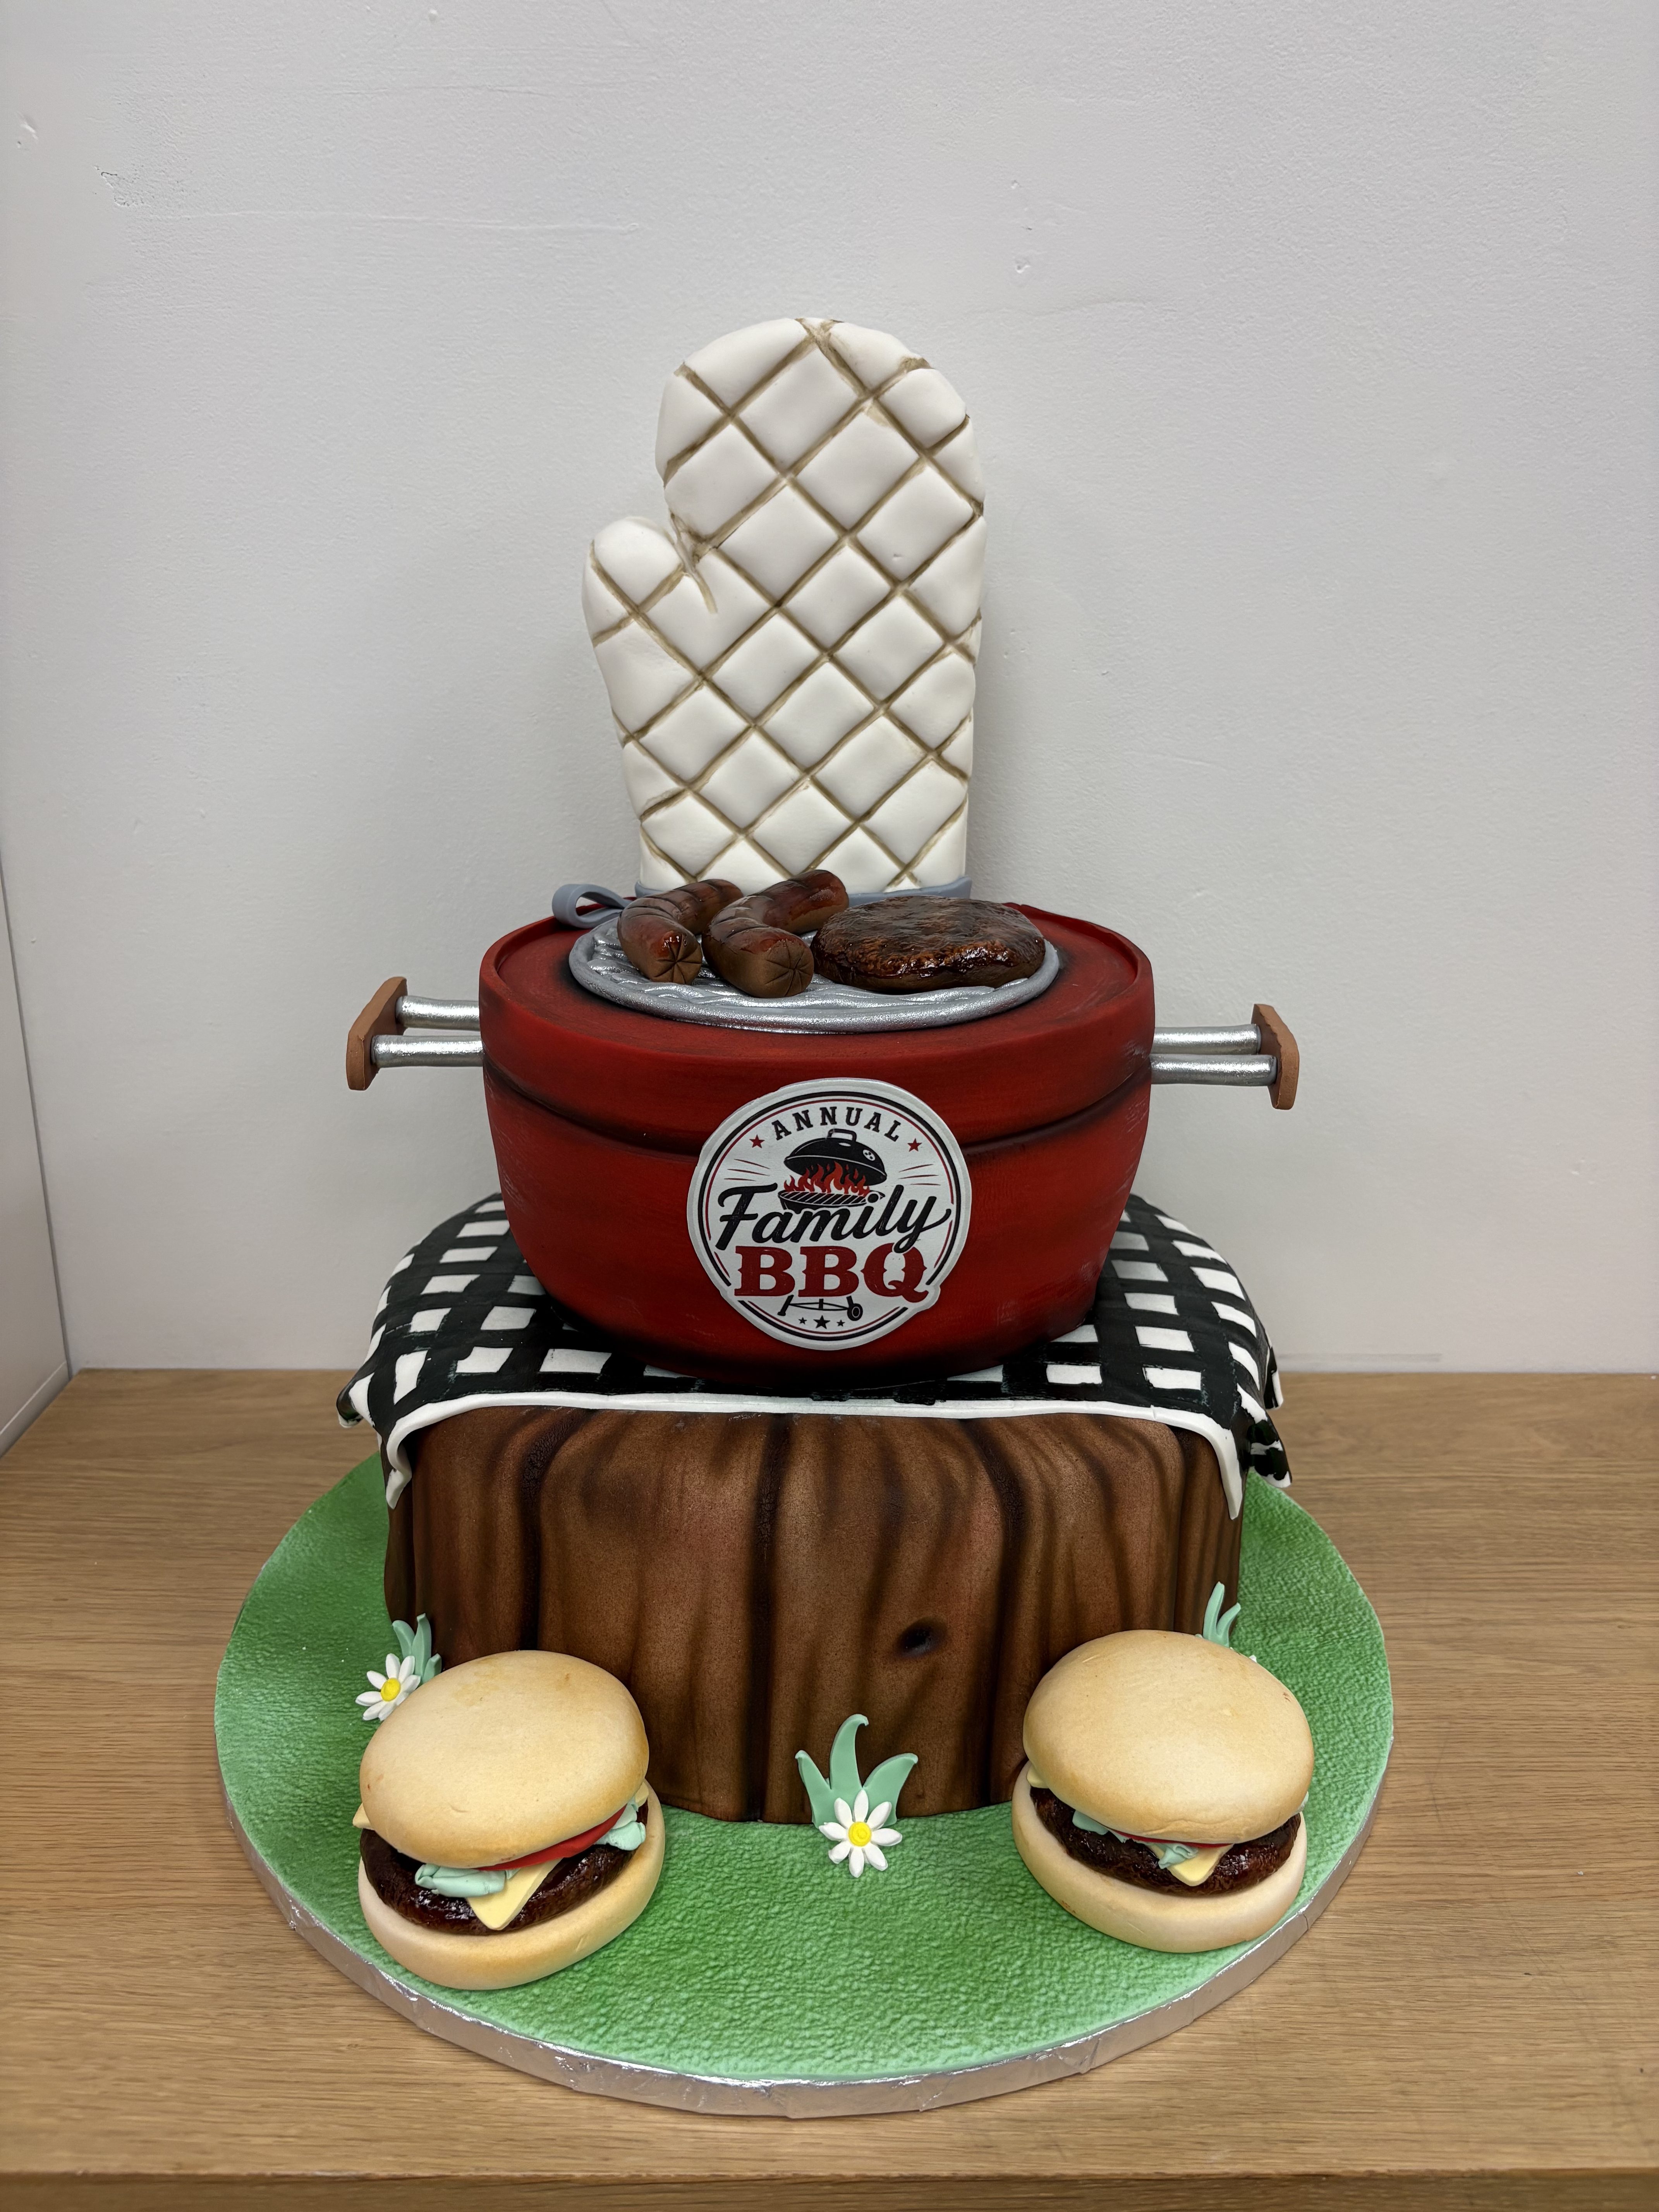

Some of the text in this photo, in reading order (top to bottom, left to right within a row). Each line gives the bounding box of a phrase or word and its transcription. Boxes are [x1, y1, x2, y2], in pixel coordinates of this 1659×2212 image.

[771, 1106, 902, 1141] ANNUAL
[715, 1183, 951, 1253] Family
[734, 1243, 929, 1303] BBQ
